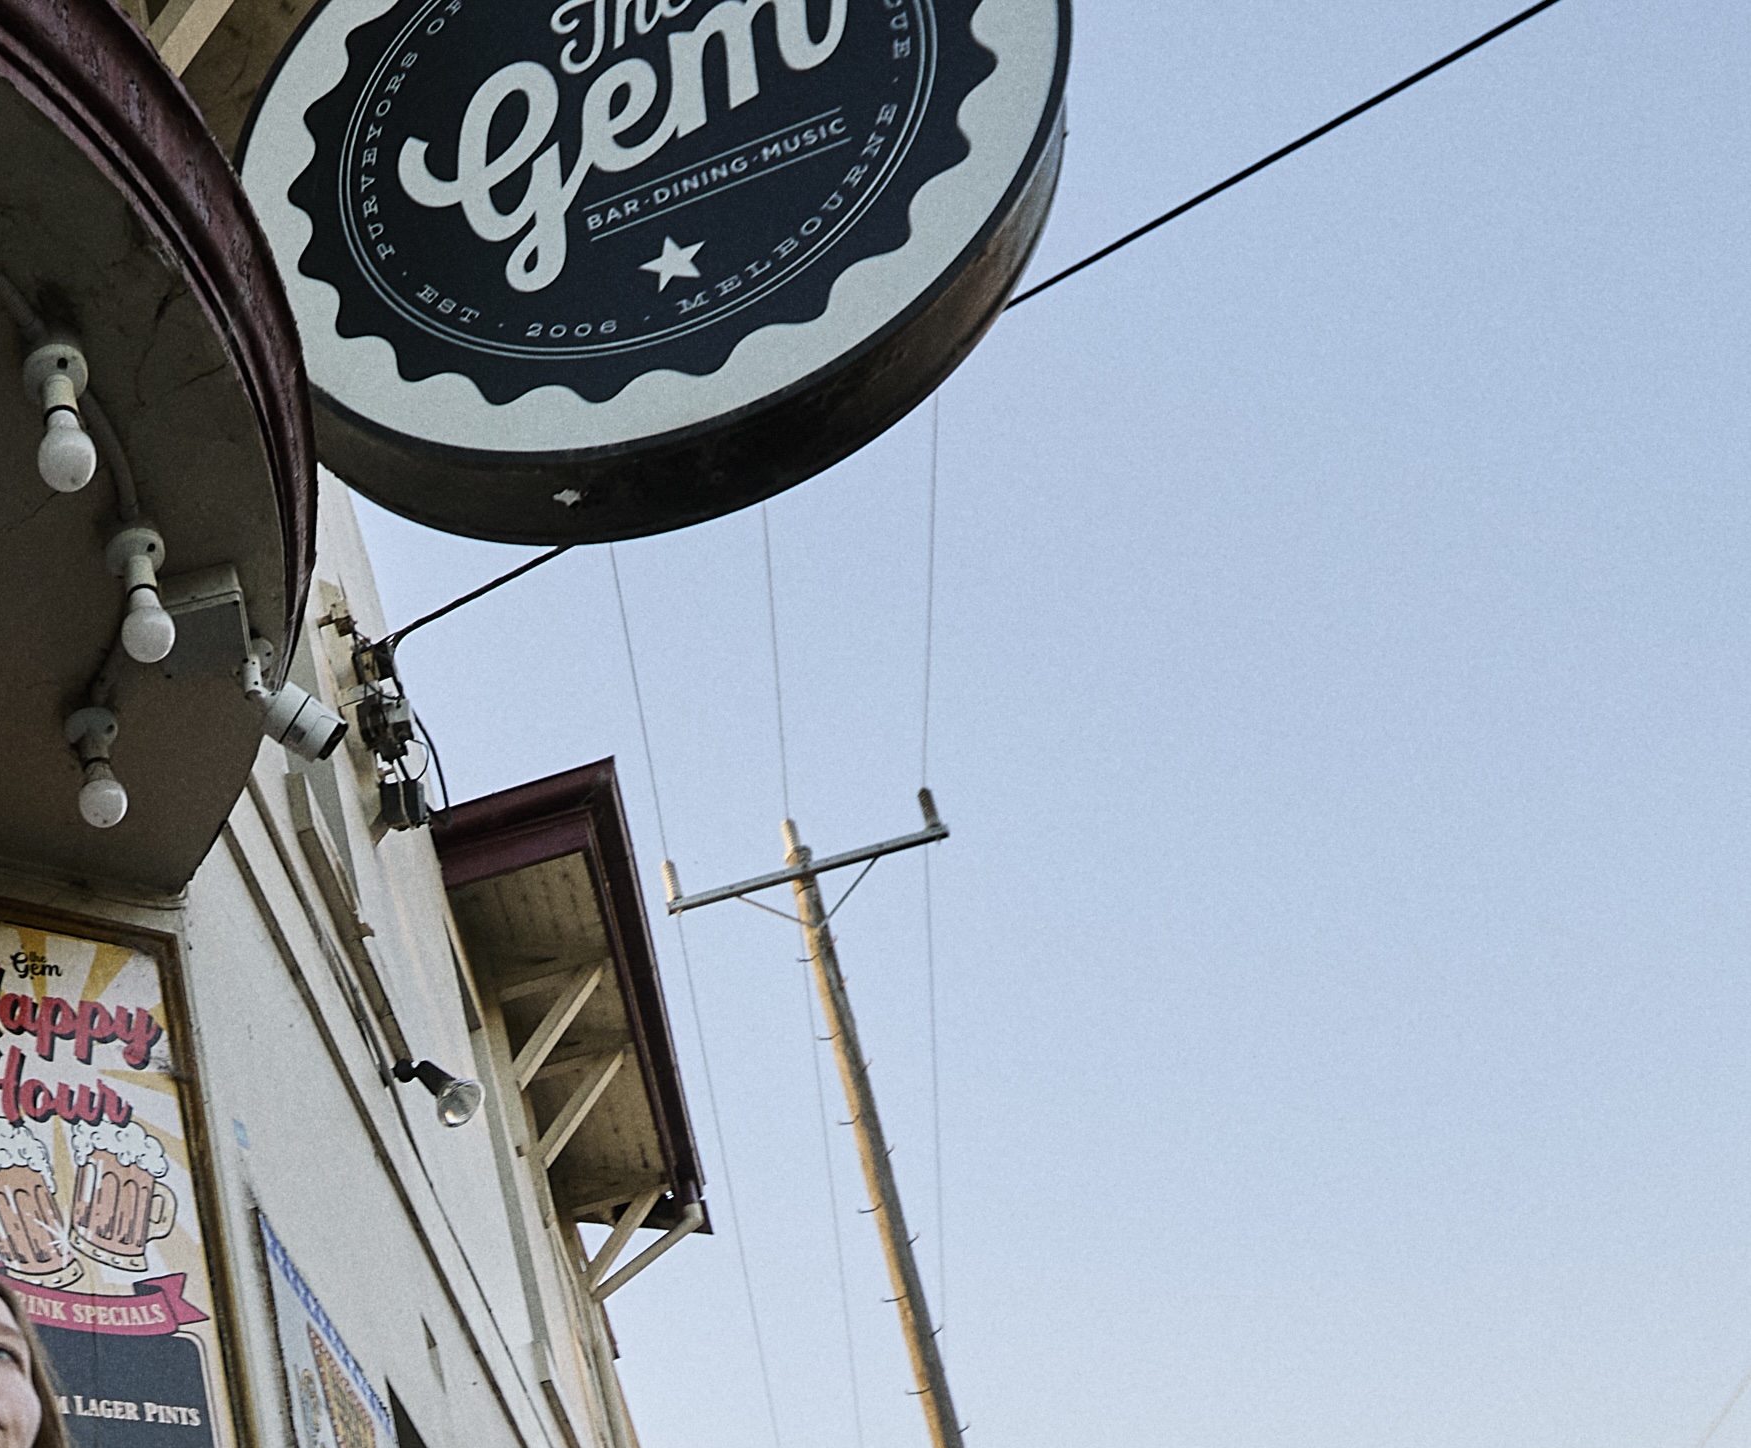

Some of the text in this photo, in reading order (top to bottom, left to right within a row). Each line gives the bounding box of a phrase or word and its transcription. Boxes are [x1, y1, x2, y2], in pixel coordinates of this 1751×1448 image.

[361, 51, 418, 260] PURVEYORS
[398, 0, 847, 292] Gem
[675, 103, 898, 315] MELBOURNE
[415, 283, 618, 338] EST 2006
[10, 951, 64, 979] Gem
[14, 1290, 167, 1326] INK SPECIALS
[73, 1395, 141, 1421] LAGER
[143, 1402, 201, 1427] PINTS
